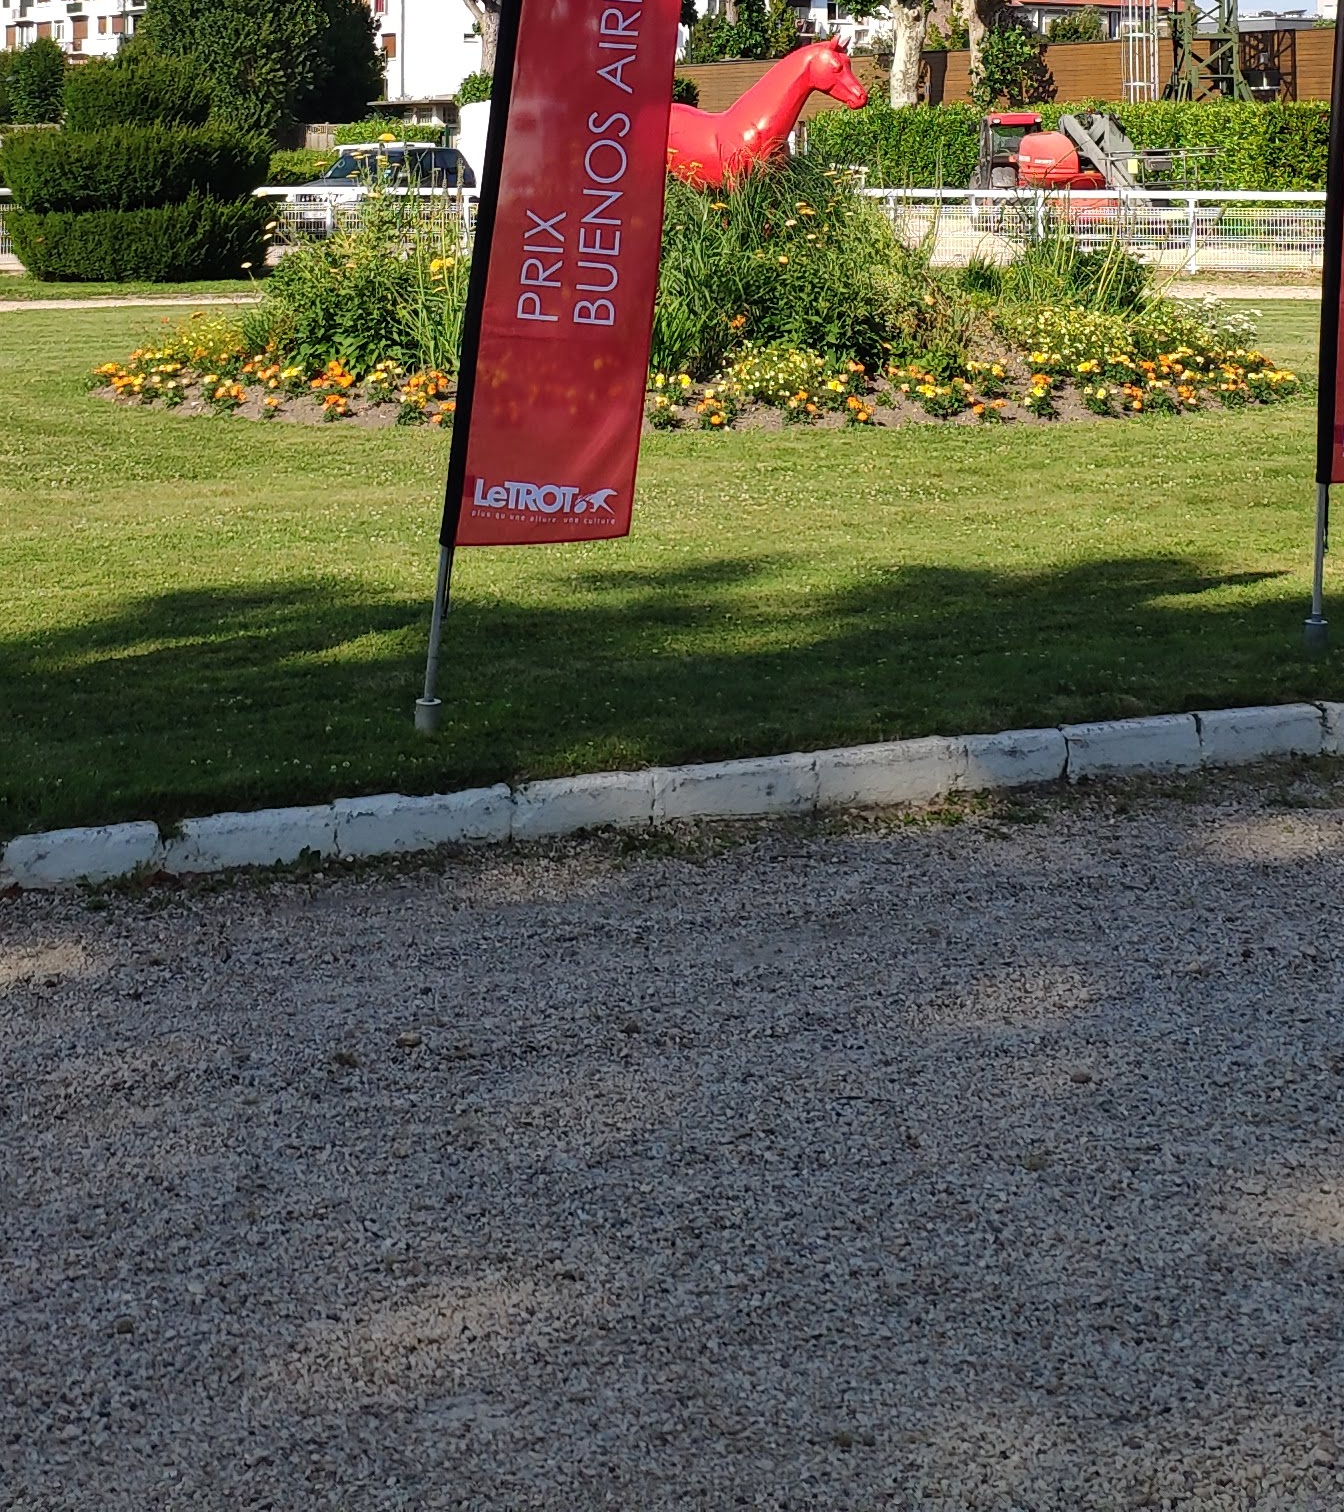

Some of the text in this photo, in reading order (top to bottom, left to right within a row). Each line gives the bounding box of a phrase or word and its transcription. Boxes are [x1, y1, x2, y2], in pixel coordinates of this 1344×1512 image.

[516, 209, 567, 322] PRIX
[573, 111, 631, 326] BUENOS
[474, 478, 579, 513] LeTROT
